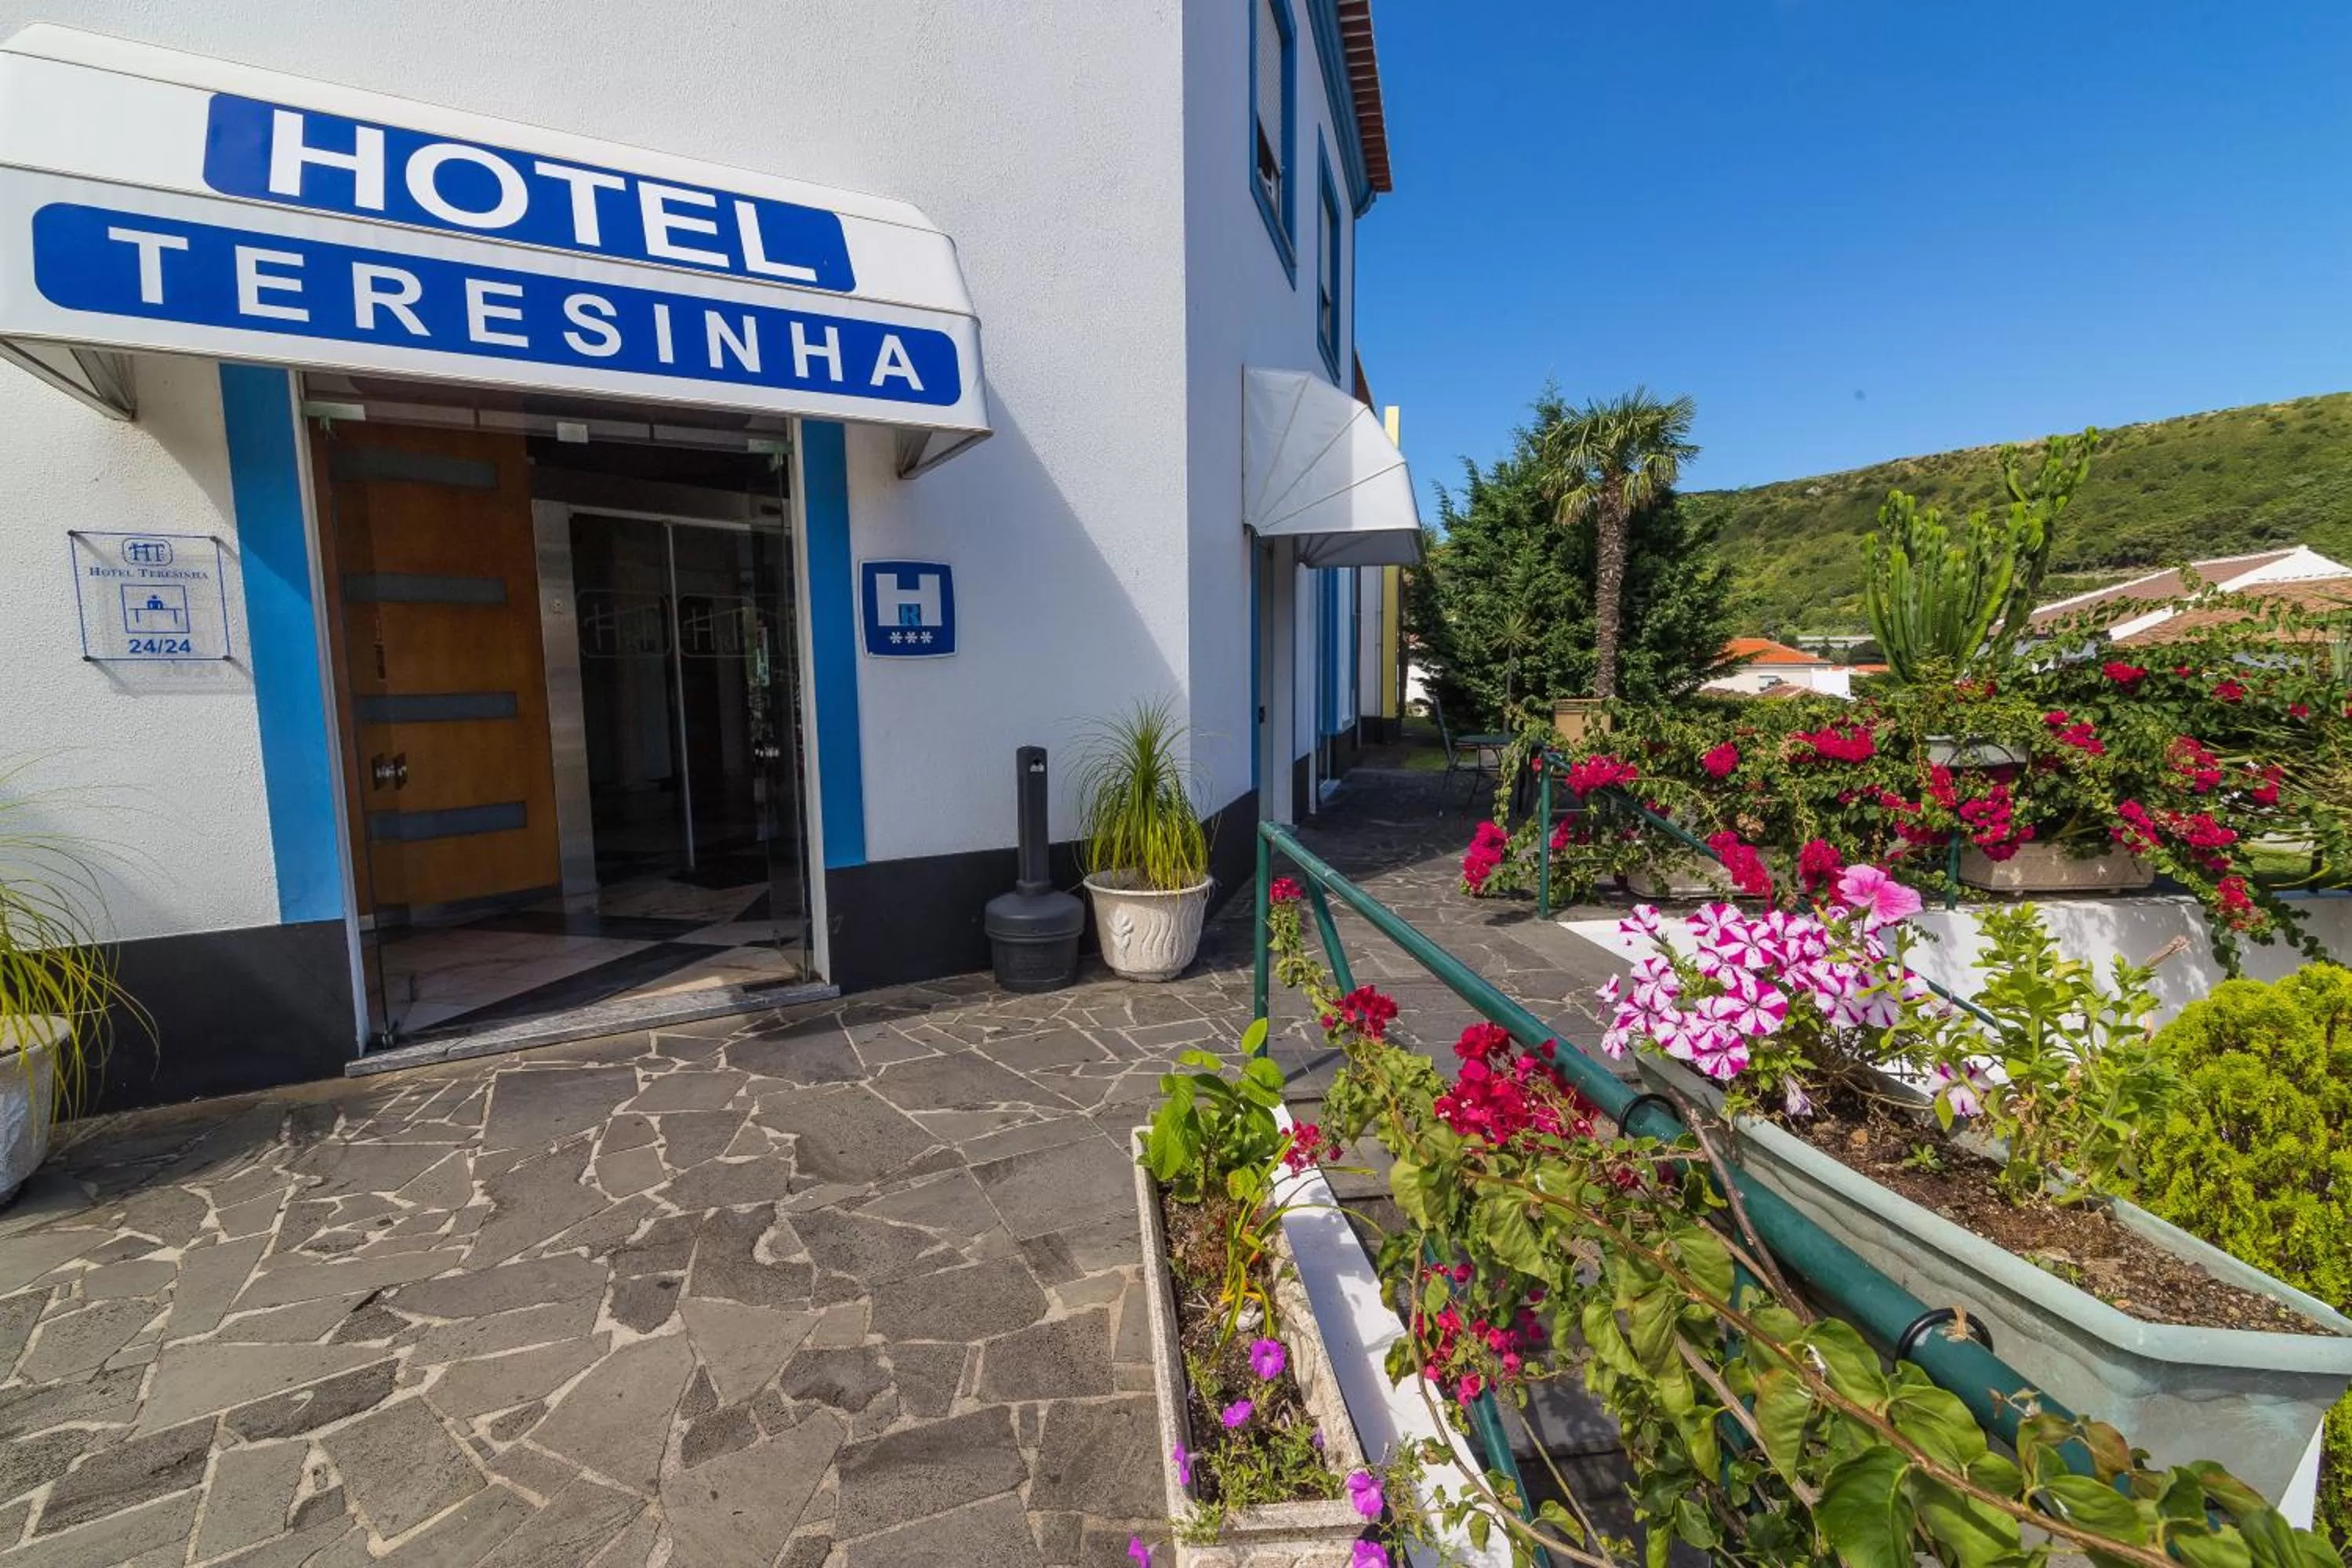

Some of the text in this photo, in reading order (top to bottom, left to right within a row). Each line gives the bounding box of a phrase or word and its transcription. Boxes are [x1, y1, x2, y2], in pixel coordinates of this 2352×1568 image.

[269, 109, 817, 282] HOTEL
[108, 227, 924, 391] TERESINHA
[89, 567, 209, 579] HOTEL TERESINHA
[875, 573, 942, 626] H
[129, 639, 191, 653] 24/24
